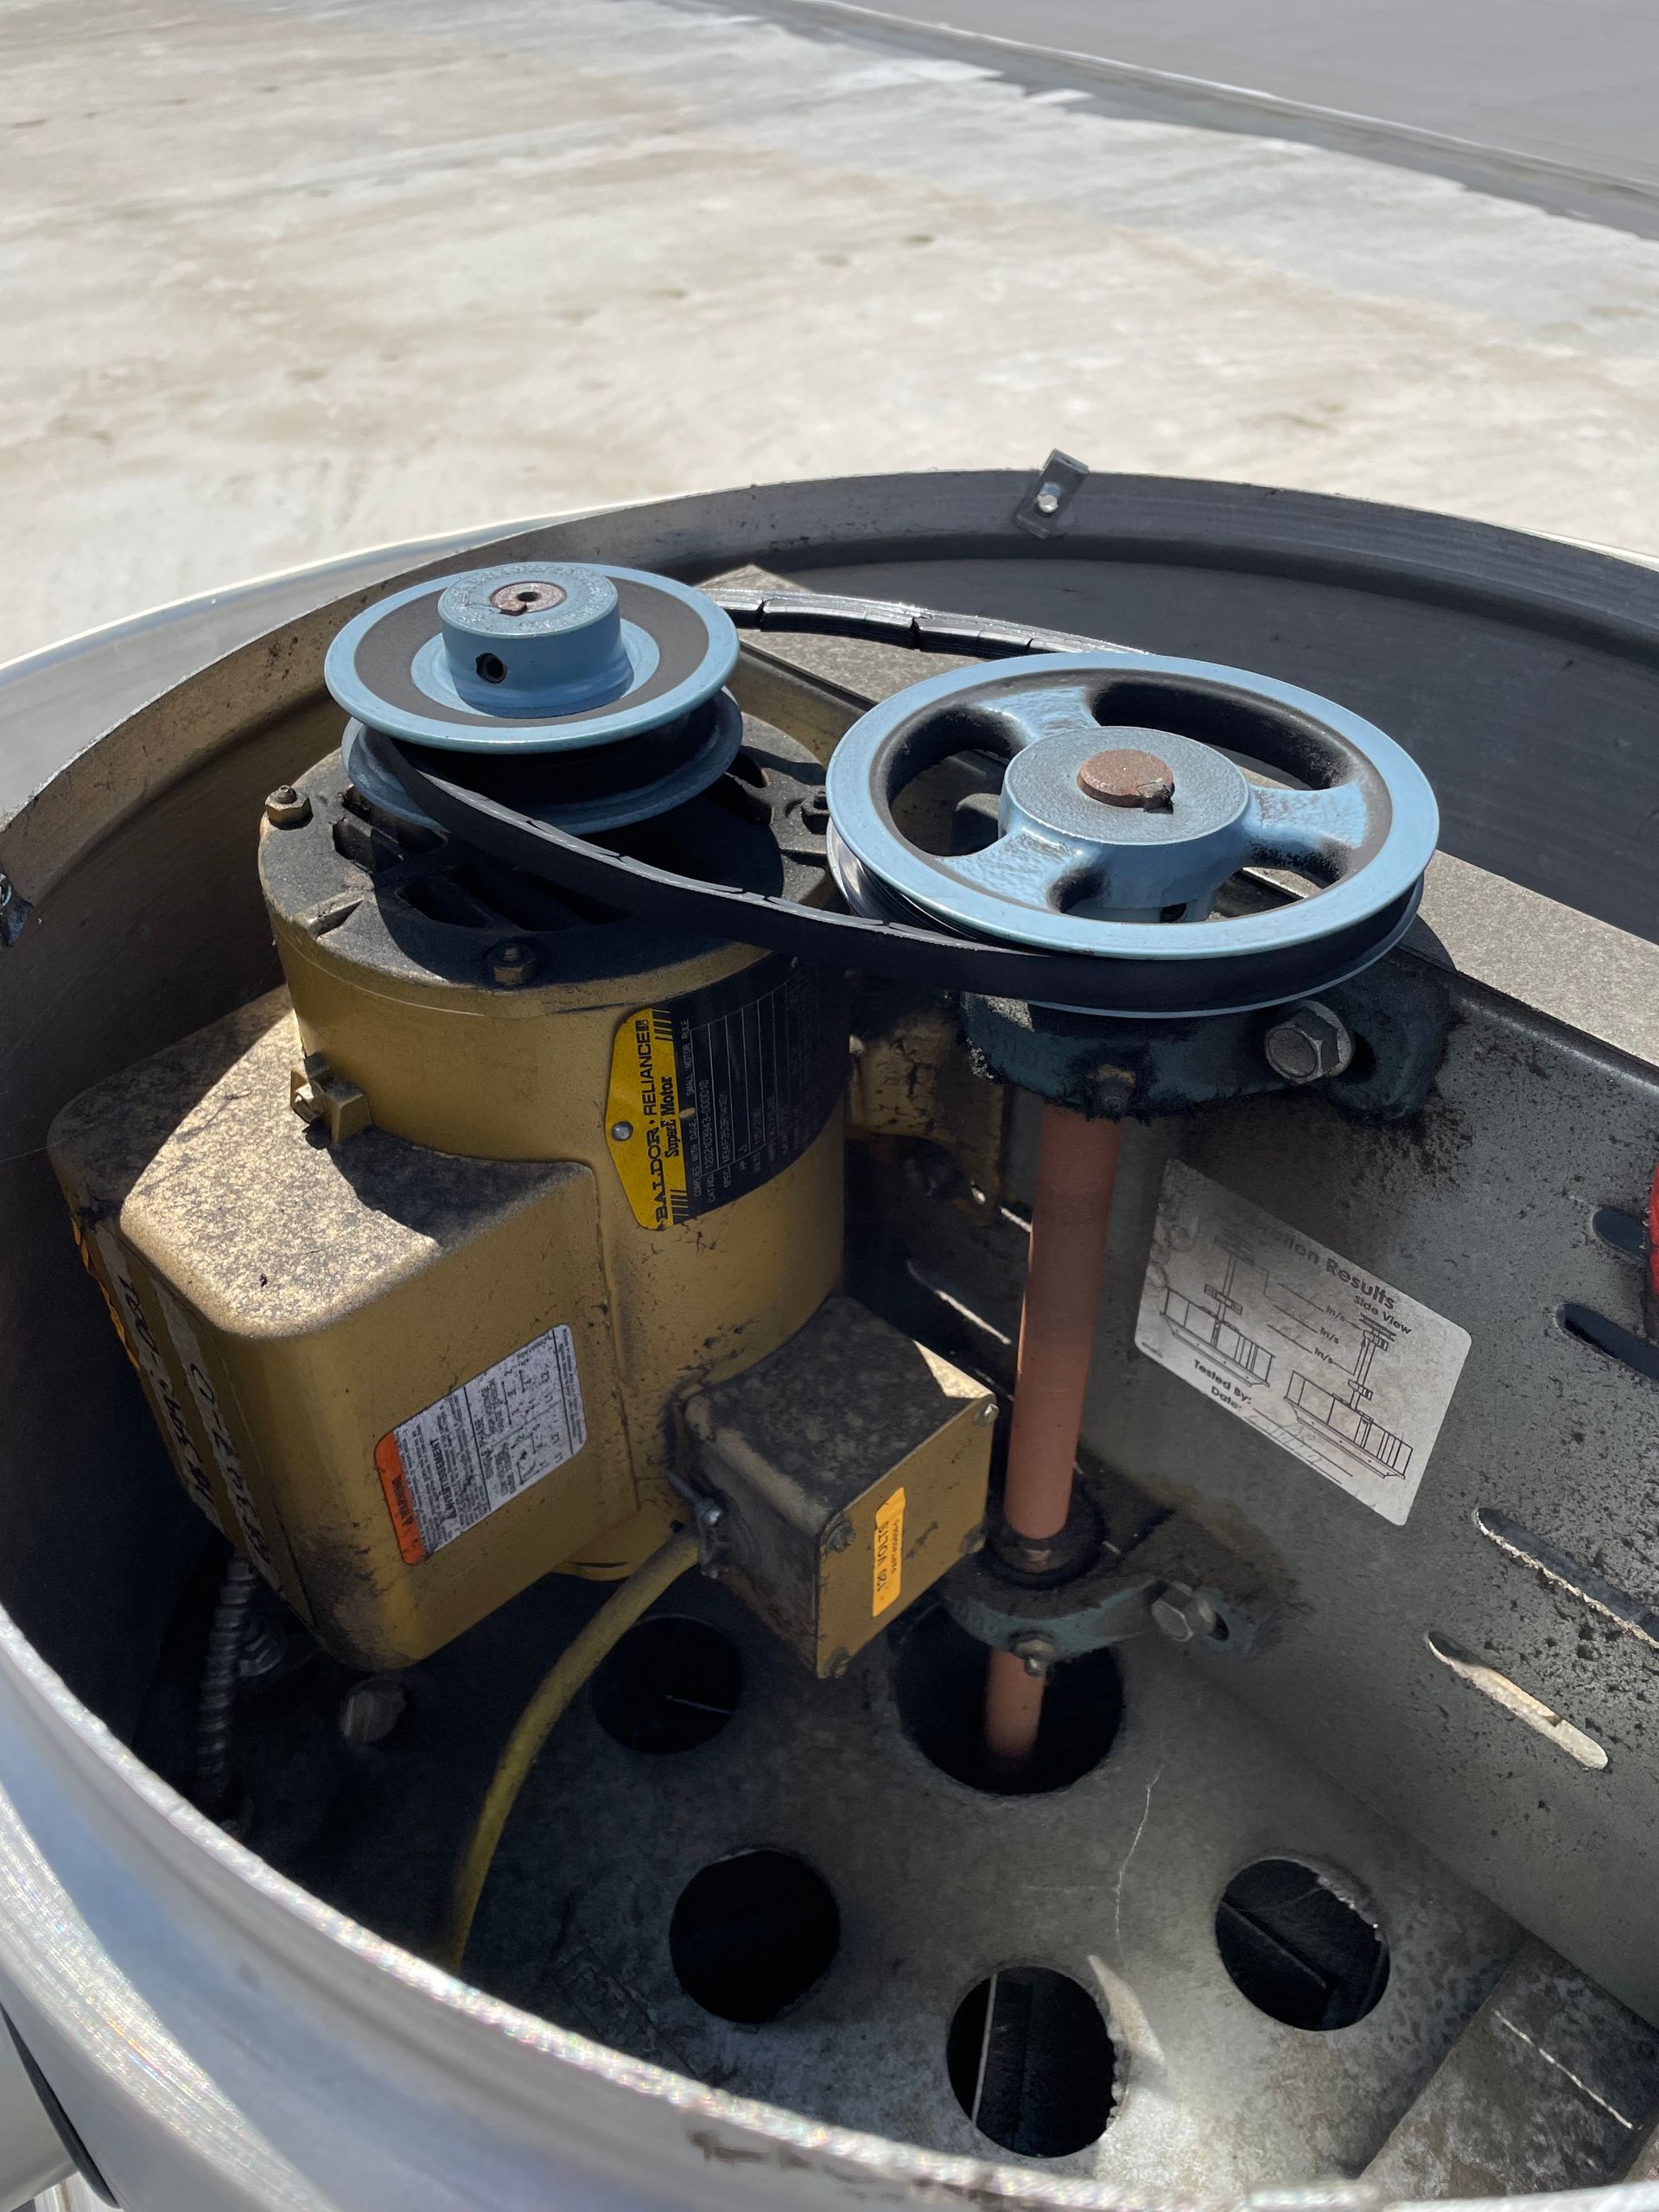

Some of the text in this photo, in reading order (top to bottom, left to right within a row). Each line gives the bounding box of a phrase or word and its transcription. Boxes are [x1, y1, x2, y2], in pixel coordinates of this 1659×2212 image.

[682, 1043, 692, 1070] MOTOR
[660, 1076, 676, 1116] Motor
[685, 1071, 695, 1096] SMALL
[636, 1030, 669, 1223] BALDOR RELIANCE
[690, 1143, 699, 1163] WITH
[692, 1166, 702, 1198] COMPLIES
[1325, 1258, 1396, 1310] Results
[1354, 1295, 1412, 1335] Side View
[1194, 1358, 1252, 1404] Tested By:
[1211, 1386, 1243, 1412] Date:
